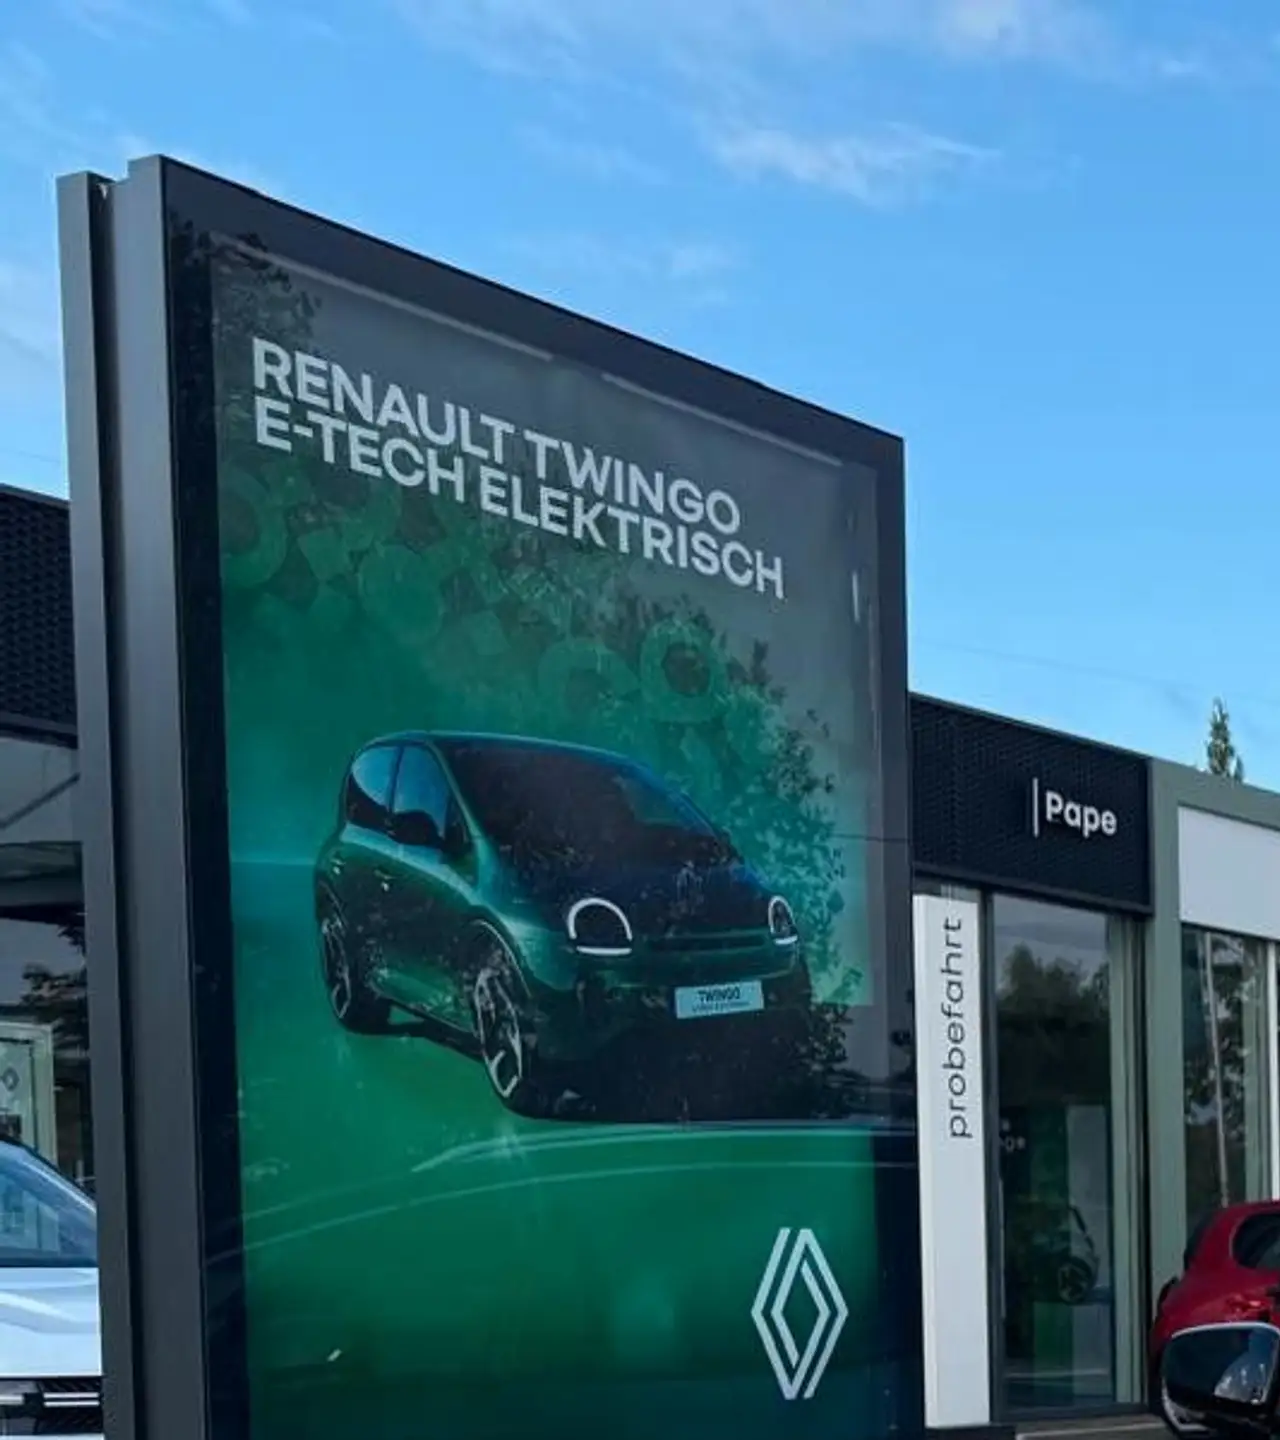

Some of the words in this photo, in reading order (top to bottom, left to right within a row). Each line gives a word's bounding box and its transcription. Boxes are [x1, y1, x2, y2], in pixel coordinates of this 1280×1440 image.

[252, 337, 515, 465] RENAULT
[524, 430, 740, 535] TWINGO
[255, 396, 464, 503] E-TECH
[479, 466, 784, 599] ELEKTRISCH
[1045, 790, 1117, 838] Pape
[941, 918, 972, 1138] probefahrt
